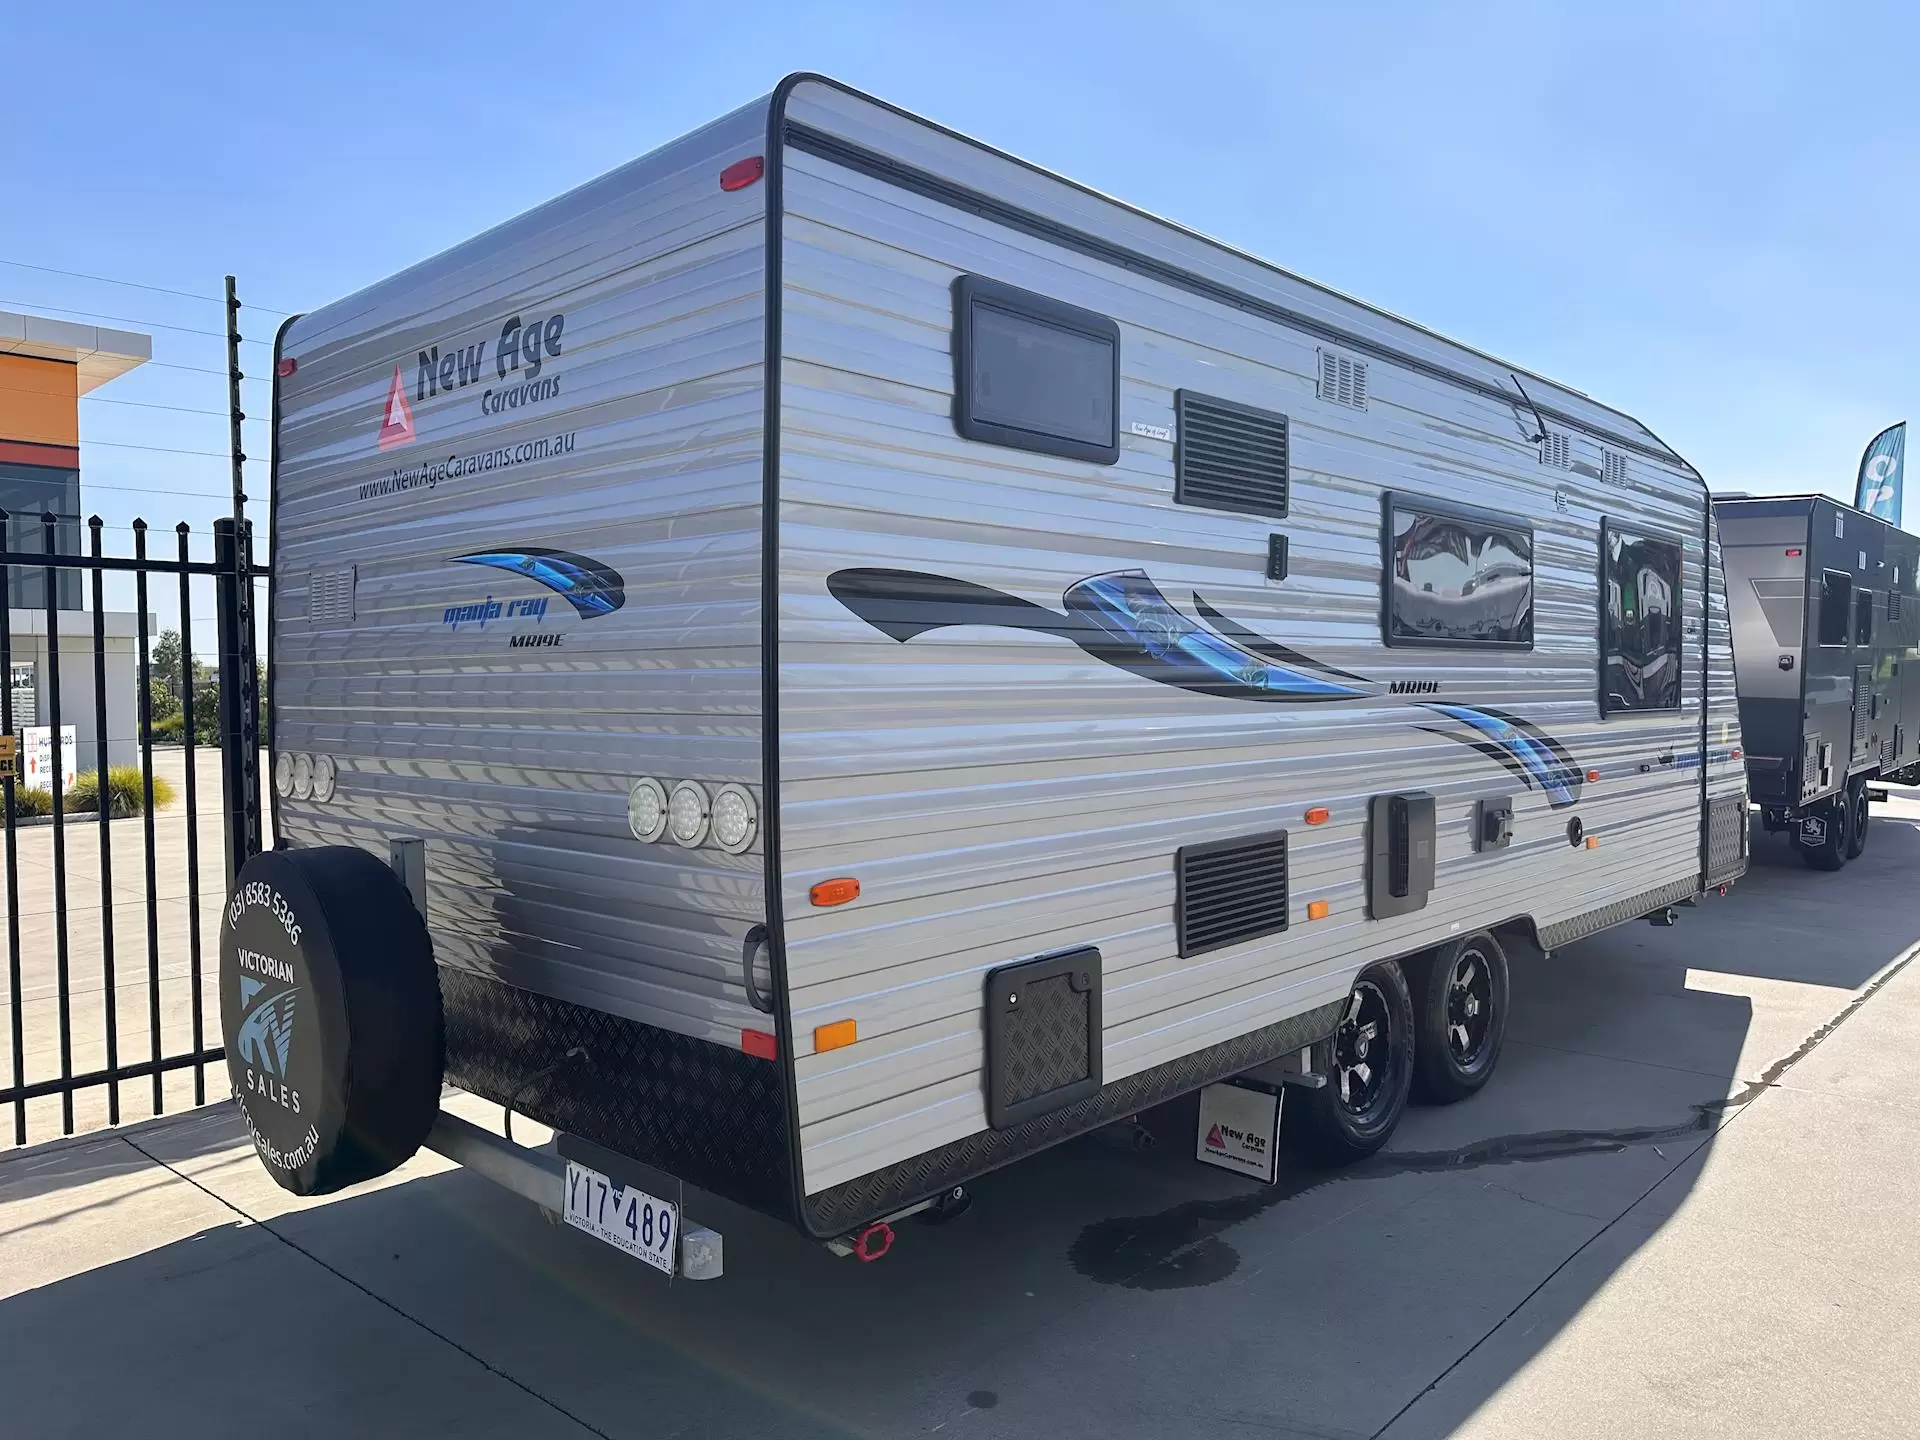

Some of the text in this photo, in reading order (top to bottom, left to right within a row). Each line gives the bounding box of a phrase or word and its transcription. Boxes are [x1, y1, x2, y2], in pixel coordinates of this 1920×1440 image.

[417, 314, 564, 400] New Age
[481, 374, 561, 415] Caravans
[359, 432, 575, 499] www.NewAgeCaravans.com.au
[228, 881, 303, 946] (03) 8583 5386
[237, 947, 294, 984] VICTORIAN
[247, 1068, 300, 1115] SALES
[1221, 1124, 1266, 1147] New Age
[569, 1167, 671, 1253] Y17 489
[569, 1214, 667, 1268] VICTORIA THE EDUCATION STATE
